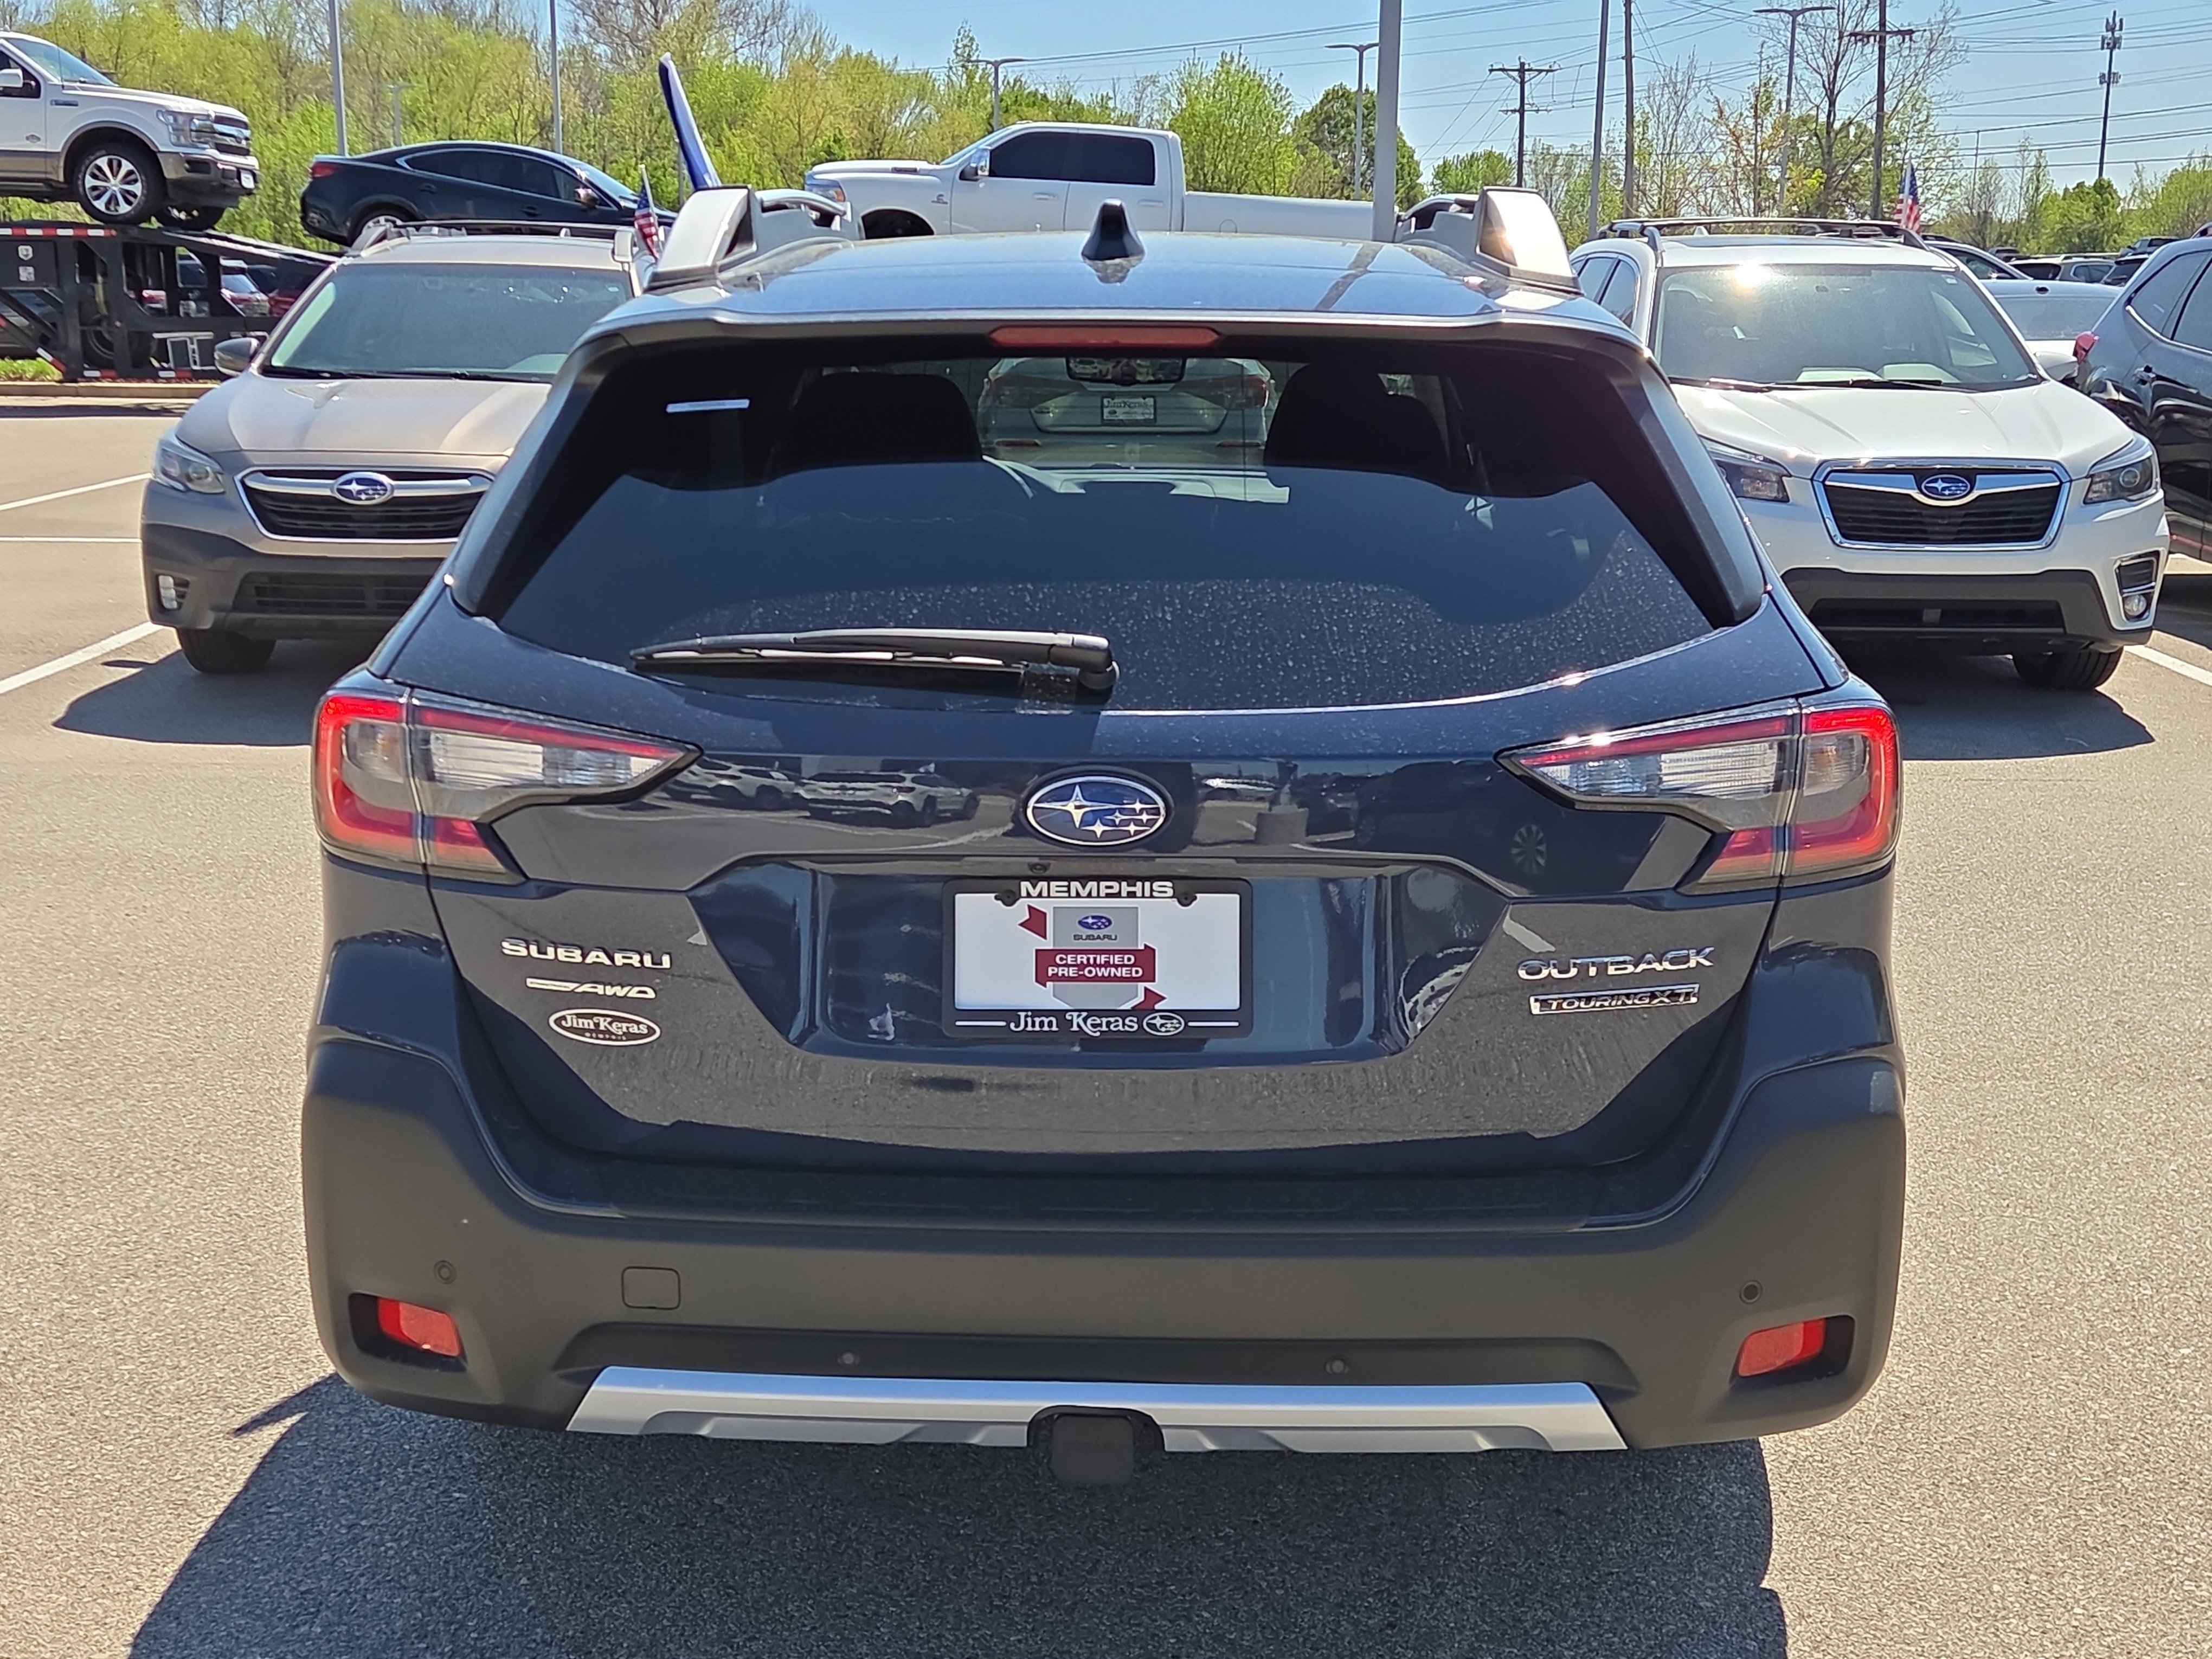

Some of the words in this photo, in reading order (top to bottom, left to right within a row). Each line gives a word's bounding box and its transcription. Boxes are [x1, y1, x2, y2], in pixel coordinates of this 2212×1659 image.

[1020, 881, 1174, 898] MEMPHIS
[500, 937, 671, 969] SUBARU
[1055, 954, 1135, 964] CERTIFIED
[1047, 967, 1143, 977] PRE-OWNED
[1517, 947, 1715, 980] OUTBACK
[574, 983, 656, 999] AWD
[561, 1014, 595, 1030] Jim
[593, 1017, 648, 1036] Keras
[1009, 1011, 1059, 1032] Jim
[1065, 1012, 1139, 1037] Keras
